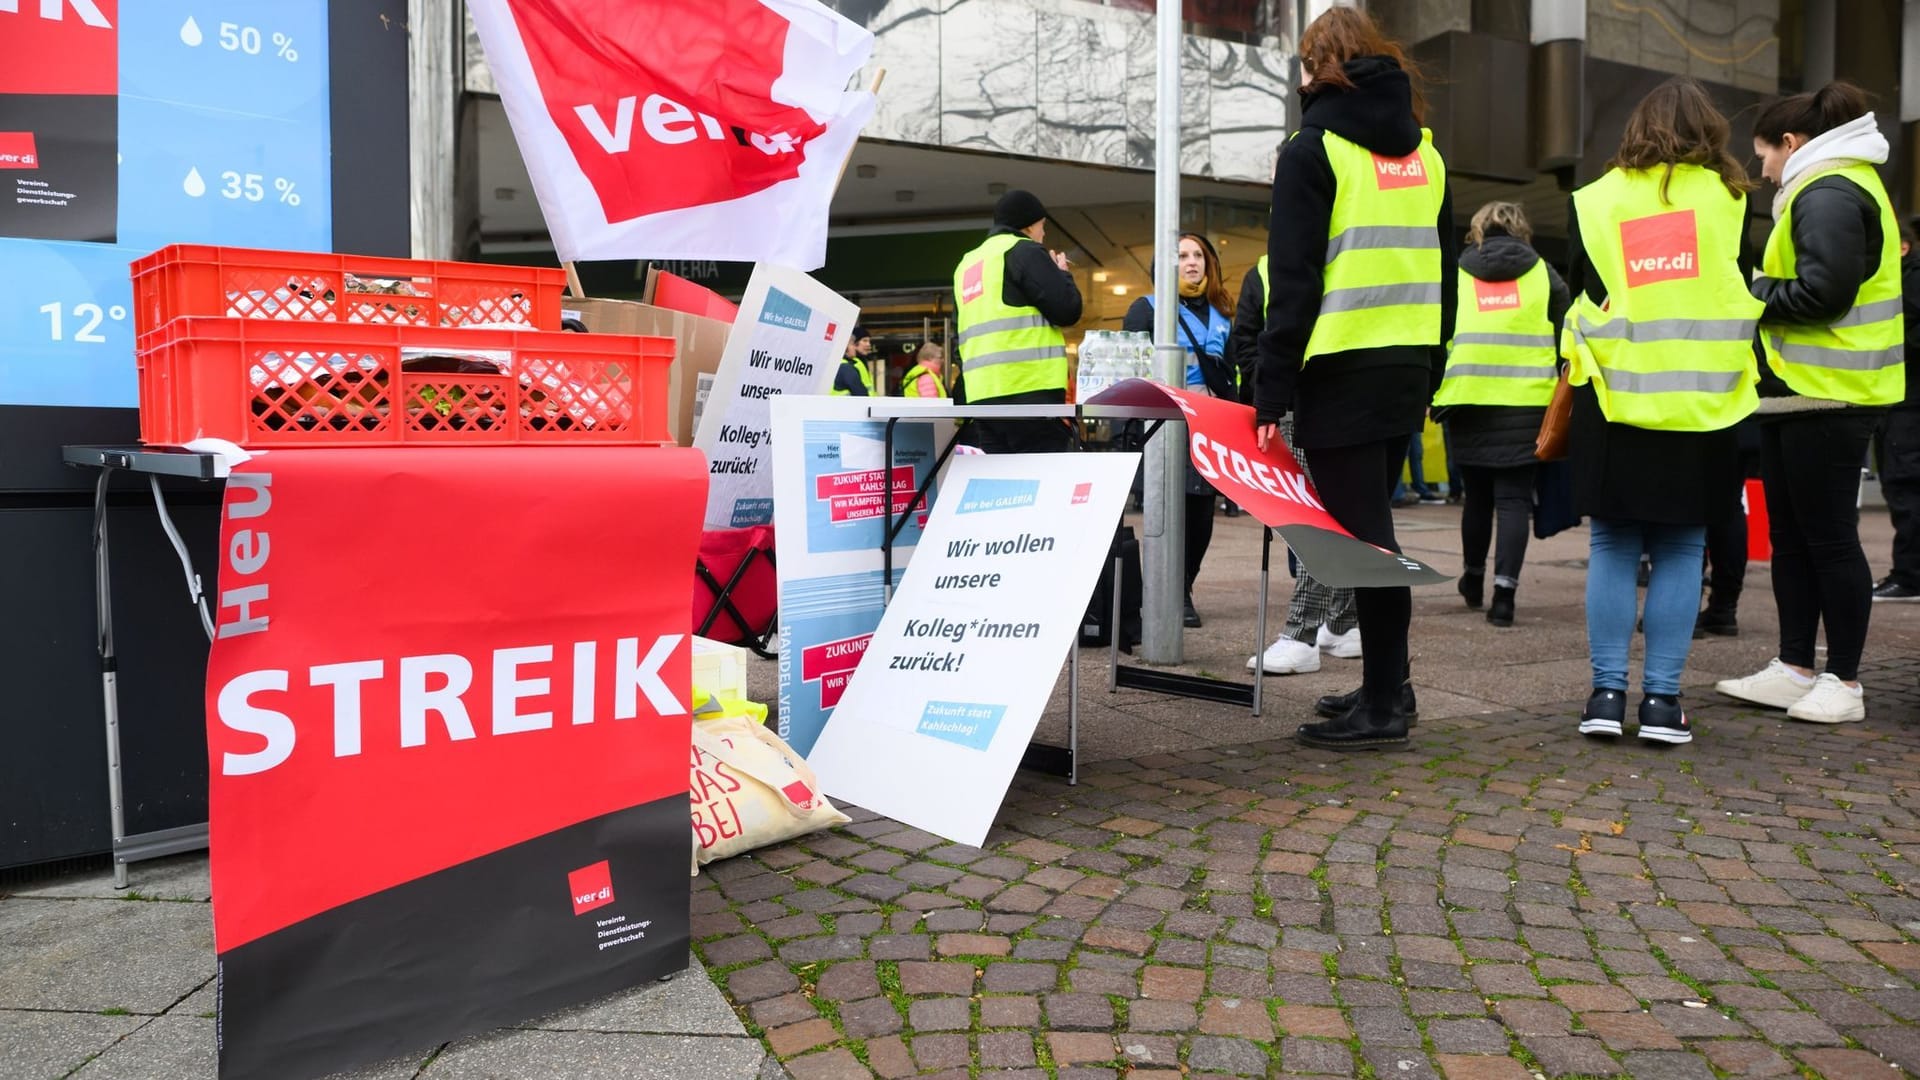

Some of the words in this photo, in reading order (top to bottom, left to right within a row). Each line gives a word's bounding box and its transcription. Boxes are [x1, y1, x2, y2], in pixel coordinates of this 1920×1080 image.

[219, 22, 262, 55] 50
[272, 32, 299, 63] %
[1377, 159, 1423, 177] ver.di
[16, 179, 49, 188] Vereinte
[220, 171, 264, 202] 35
[274, 177, 301, 207] %
[16, 188, 77, 199] Dienstleistungs-
[16, 197, 68, 206] gewerkschaft
[1628, 252, 1694, 273] ver.di
[1479, 293, 1518, 305] ver.di
[39, 302, 127, 343] 12°
[749, 349, 772, 369] Wir
[774, 356, 813, 376] wollen
[827, 444, 840, 452] Hier
[710, 456, 758, 474] zurück!
[1192, 431, 1328, 513] STREIK
[833, 474, 867, 486] ZUKUNFT
[869, 471, 886, 482] STAT
[834, 500, 847, 508] WIR
[848, 495, 882, 507] KÄMPFEN
[996, 493, 1034, 507] GALERIA
[846, 506, 874, 519] UNSEREN
[946, 538, 979, 558] Wir
[985, 534, 1055, 556] wollen
[217, 472, 272, 640] Heu
[934, 571, 1001, 590] unsere
[825, 638, 872, 659] ZUKUNF
[888, 652, 965, 673] zurück!
[827, 677, 844, 688] WIR
[217, 634, 687, 776] STREIK
[927, 704, 966, 718] Zukunft
[967, 708, 993, 719] statt
[922, 720, 978, 737] Kahlschlag!
[575, 886, 611, 905] ver.di
[596, 915, 626, 928] Vereinte
[597, 920, 652, 939] Dienstleistungs-
[598, 932, 645, 950] gewerkschaft
